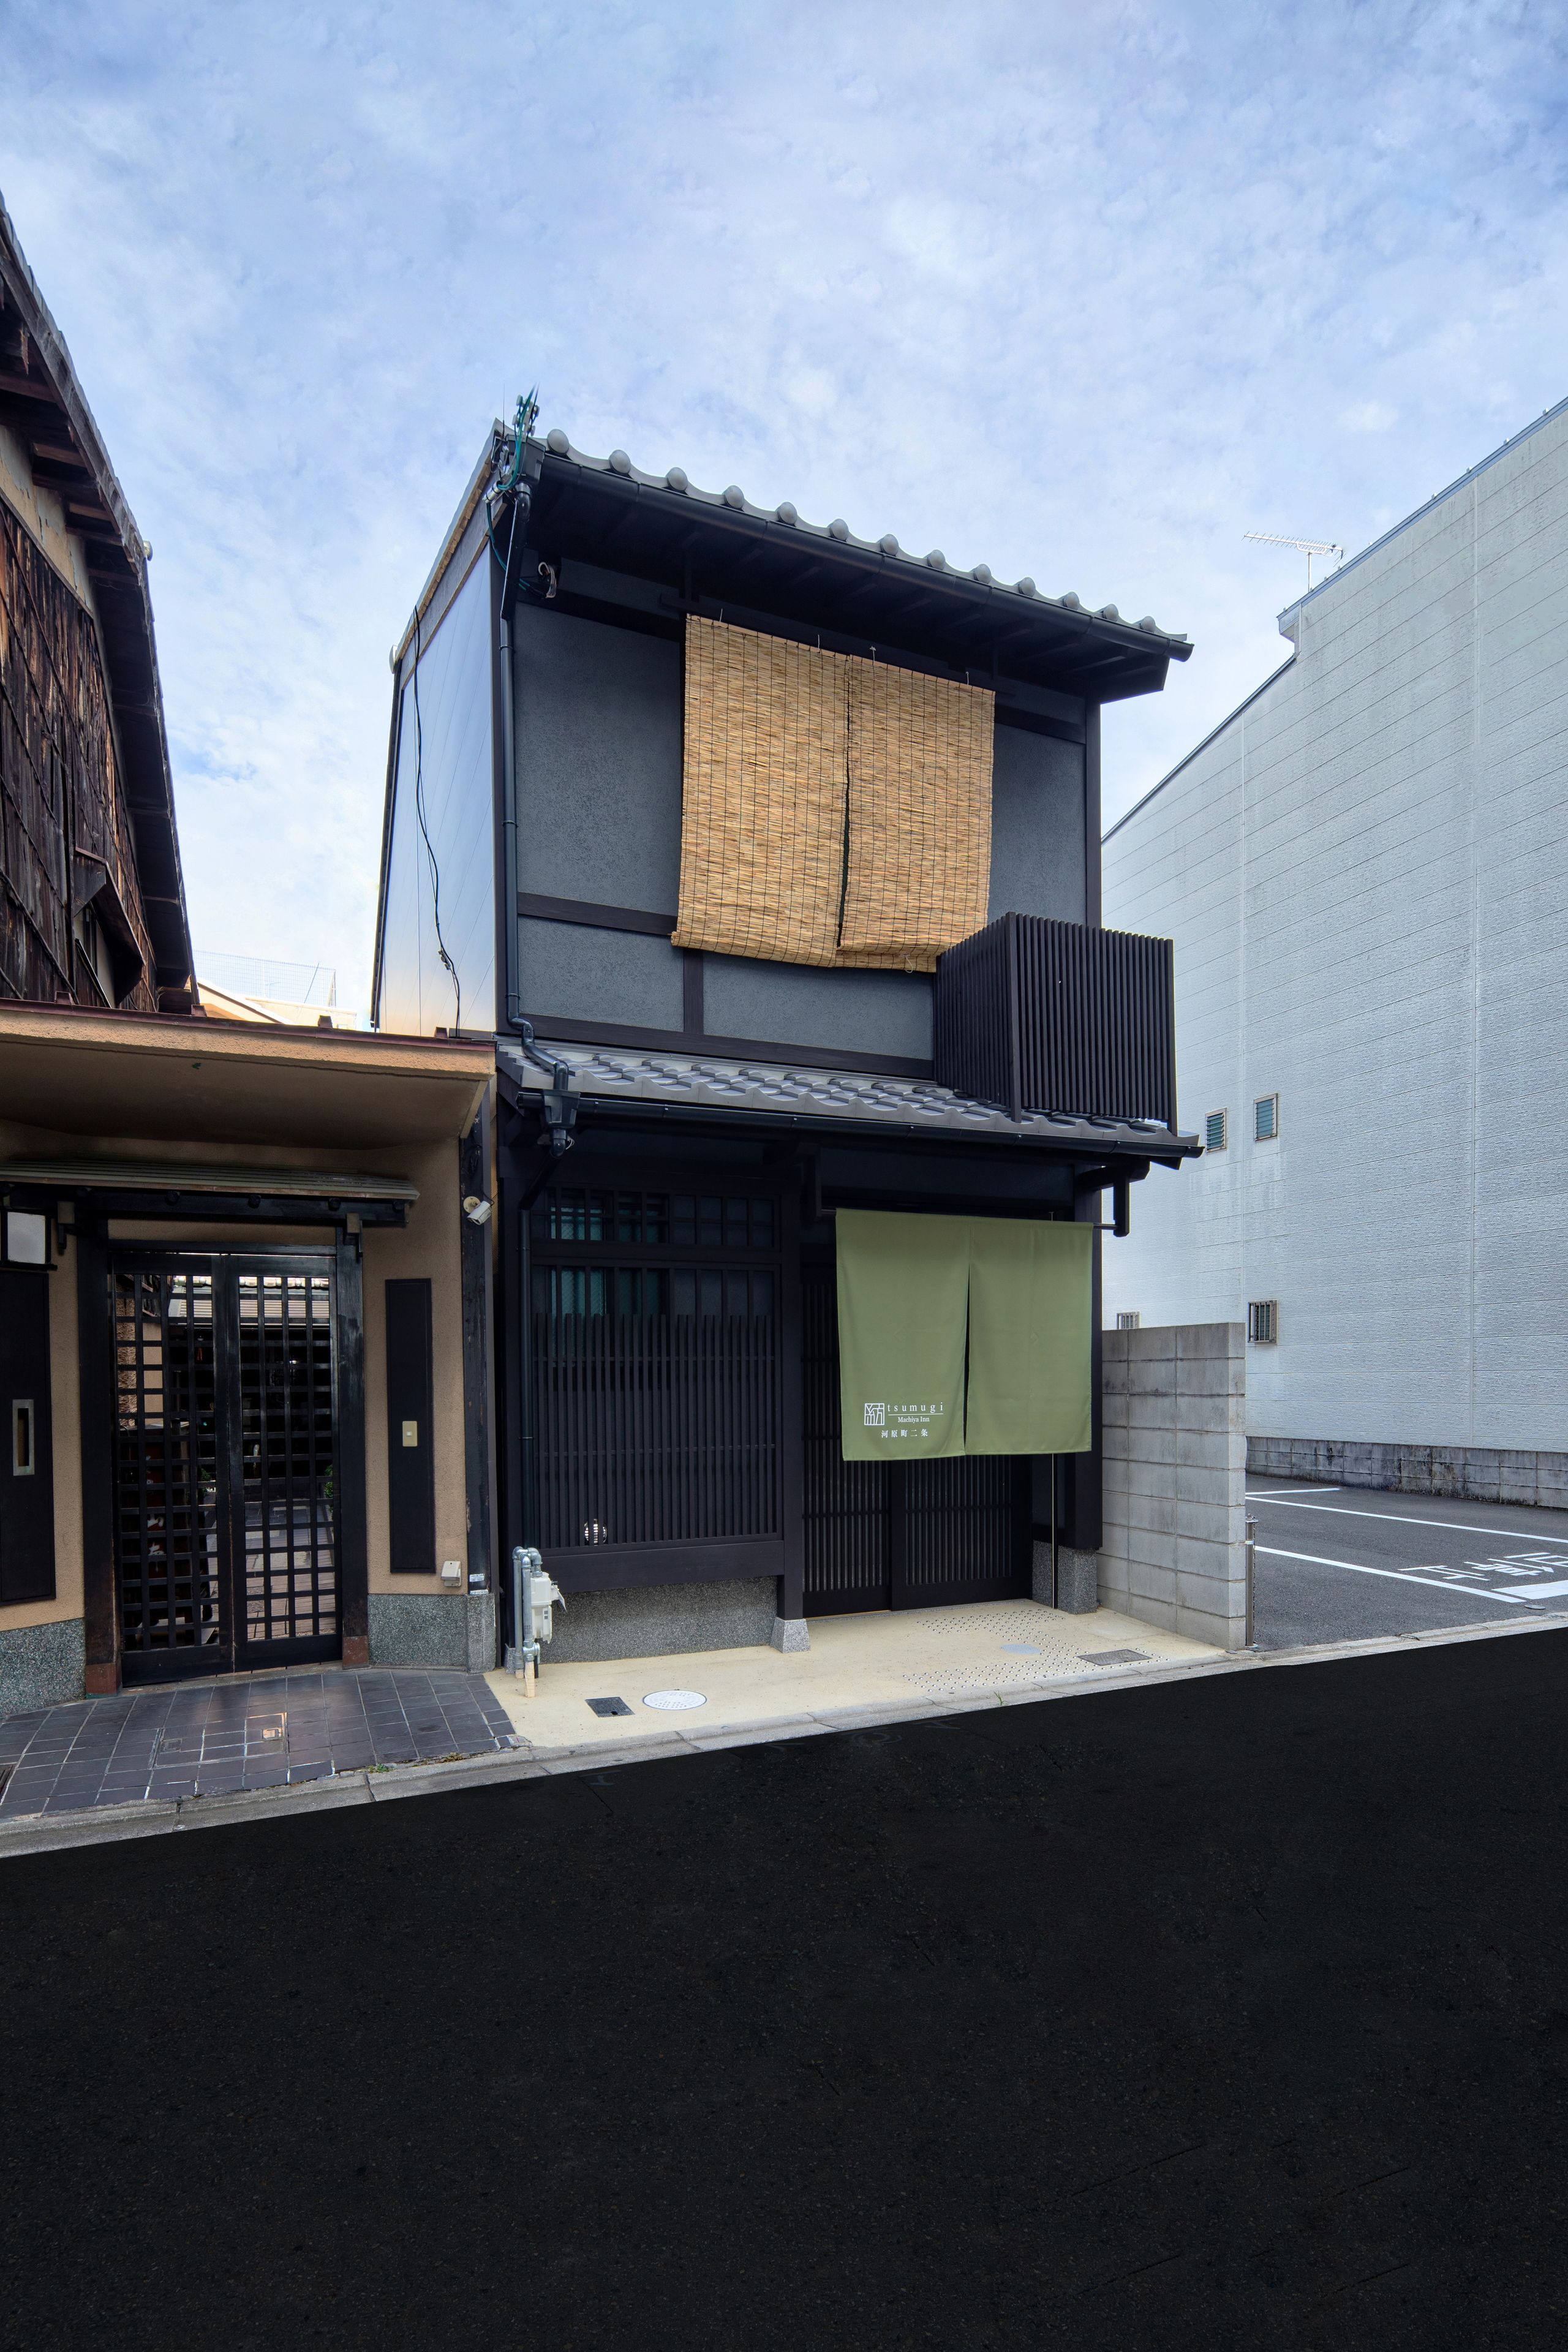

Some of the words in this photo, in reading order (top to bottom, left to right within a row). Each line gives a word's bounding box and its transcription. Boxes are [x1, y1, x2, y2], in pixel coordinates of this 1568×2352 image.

[888, 1402, 944, 1414] tsumugi
[881, 1428, 929, 1438] 河原町二条
